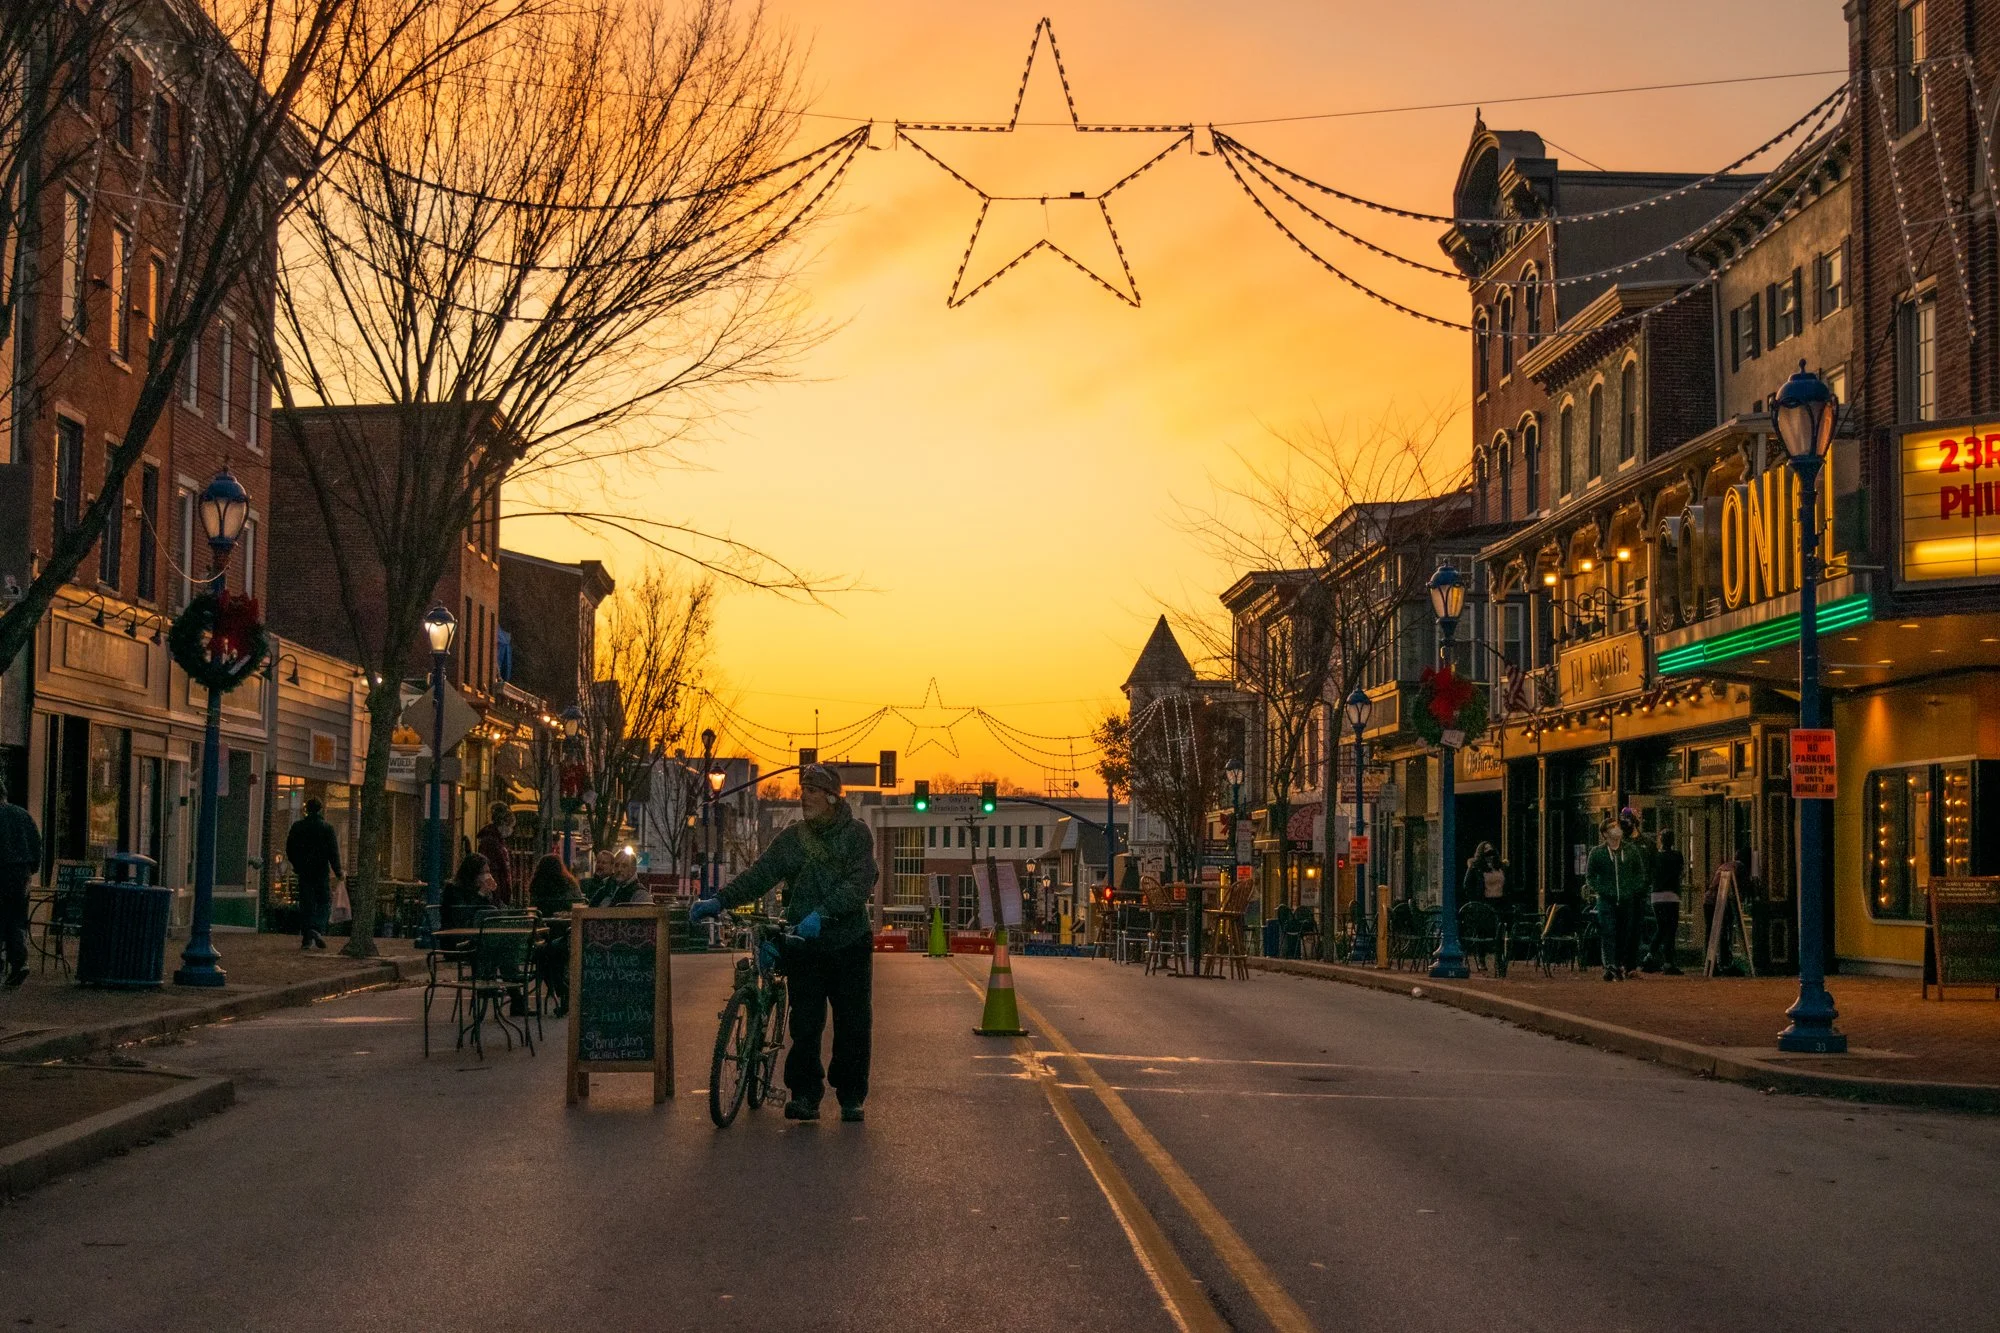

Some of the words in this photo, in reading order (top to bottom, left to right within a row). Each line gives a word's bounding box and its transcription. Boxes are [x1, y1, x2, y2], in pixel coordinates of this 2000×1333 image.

[1807, 743, 1818, 752] NO
[1795, 754, 1831, 763] PARKING
[1794, 765, 1817, 775] FRIDAY
[1818, 765, 1823, 775] 2
[1824, 765, 1835, 775] PM
[1796, 784, 1818, 793] MONDAY
[606, 951, 640, 968] have
[583, 969, 614, 981] new
[1815, 1042, 1827, 1052] 33
